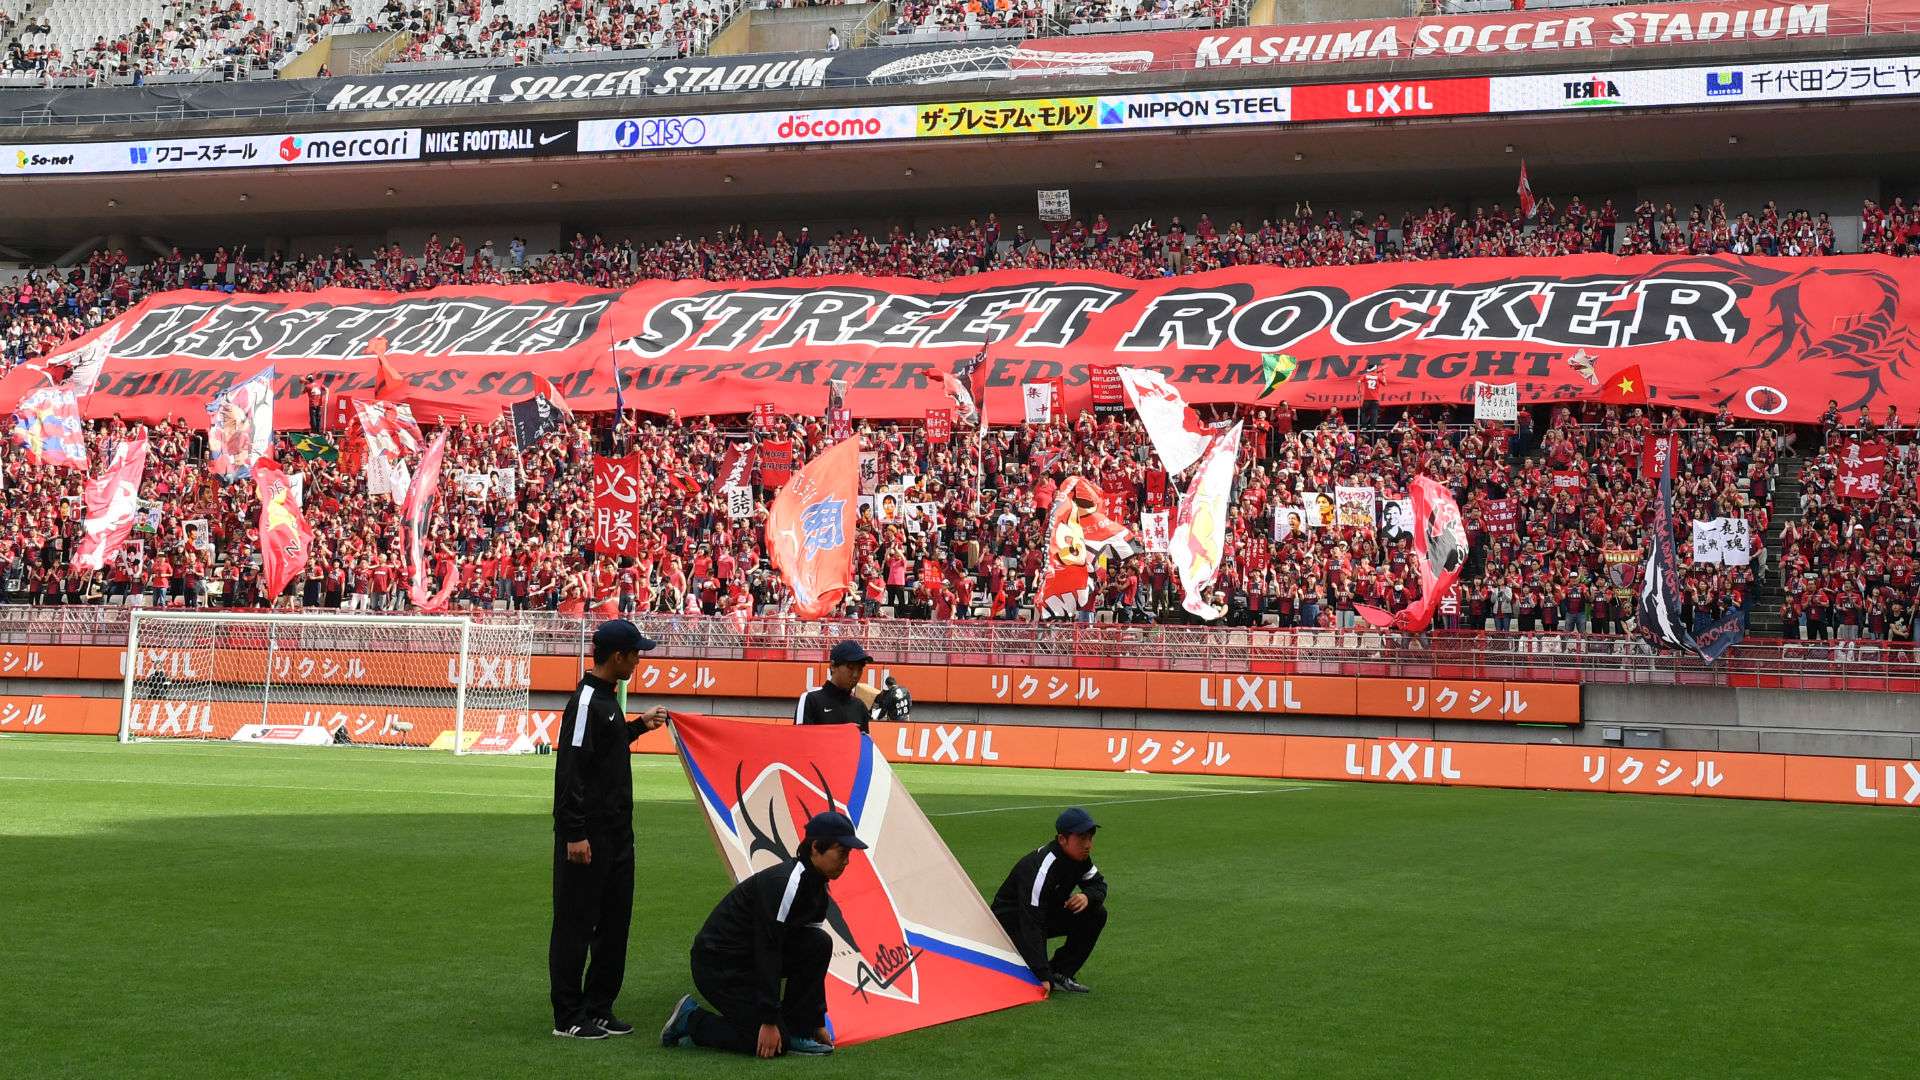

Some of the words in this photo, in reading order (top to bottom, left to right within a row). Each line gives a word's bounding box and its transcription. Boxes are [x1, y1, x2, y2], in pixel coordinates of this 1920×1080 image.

[1195, 25, 1399, 68] KASHIMA
[1413, 17, 1594, 56] SOCCER
[1608, 4, 1830, 45] STADIUM
[326, 75, 496, 111] KASHIMA
[499, 67, 653, 101] SOCCER
[653, 57, 835, 94] STADIUM
[1751, 65, 1920, 94] 千代田グラビヤ
[1128, 100, 1209, 119] NIPPON
[1215, 97, 1285, 115] STEEL
[1346, 84, 1434, 115] LIXIL
[642, 117, 706, 147] RISO
[777, 115, 881, 139] docomo
[921, 104, 1094, 132] ザ・プレミアム・モルツ
[156, 143, 257, 163] ワコースチール
[306, 131, 409, 158] mercari
[425, 132, 459, 153] NIKE
[463, 129, 534, 151] FOOTBALL
[30, 154, 74, 166] So-net
[612, 283, 1130, 359] STREET
[1114, 273, 1748, 353] ROCKER
[607, 359, 936, 394] SUPPORTER
[595, 461, 638, 551] 必勝
[275, 655, 366, 680] リクシル
[628, 665, 716, 689] クシル
[991, 674, 1100, 700] リクシル
[1200, 675, 1301, 712] LIXIL
[1406, 686, 1528, 714] リクシル
[130, 702, 215, 735] LIXIL
[897, 723, 999, 763] LIXIL
[1107, 736, 1232, 767] リクシル
[1345, 741, 1461, 781] LIXIL
[1583, 755, 1724, 788] リクシル
[852, 944, 923, 1004] Antlers
